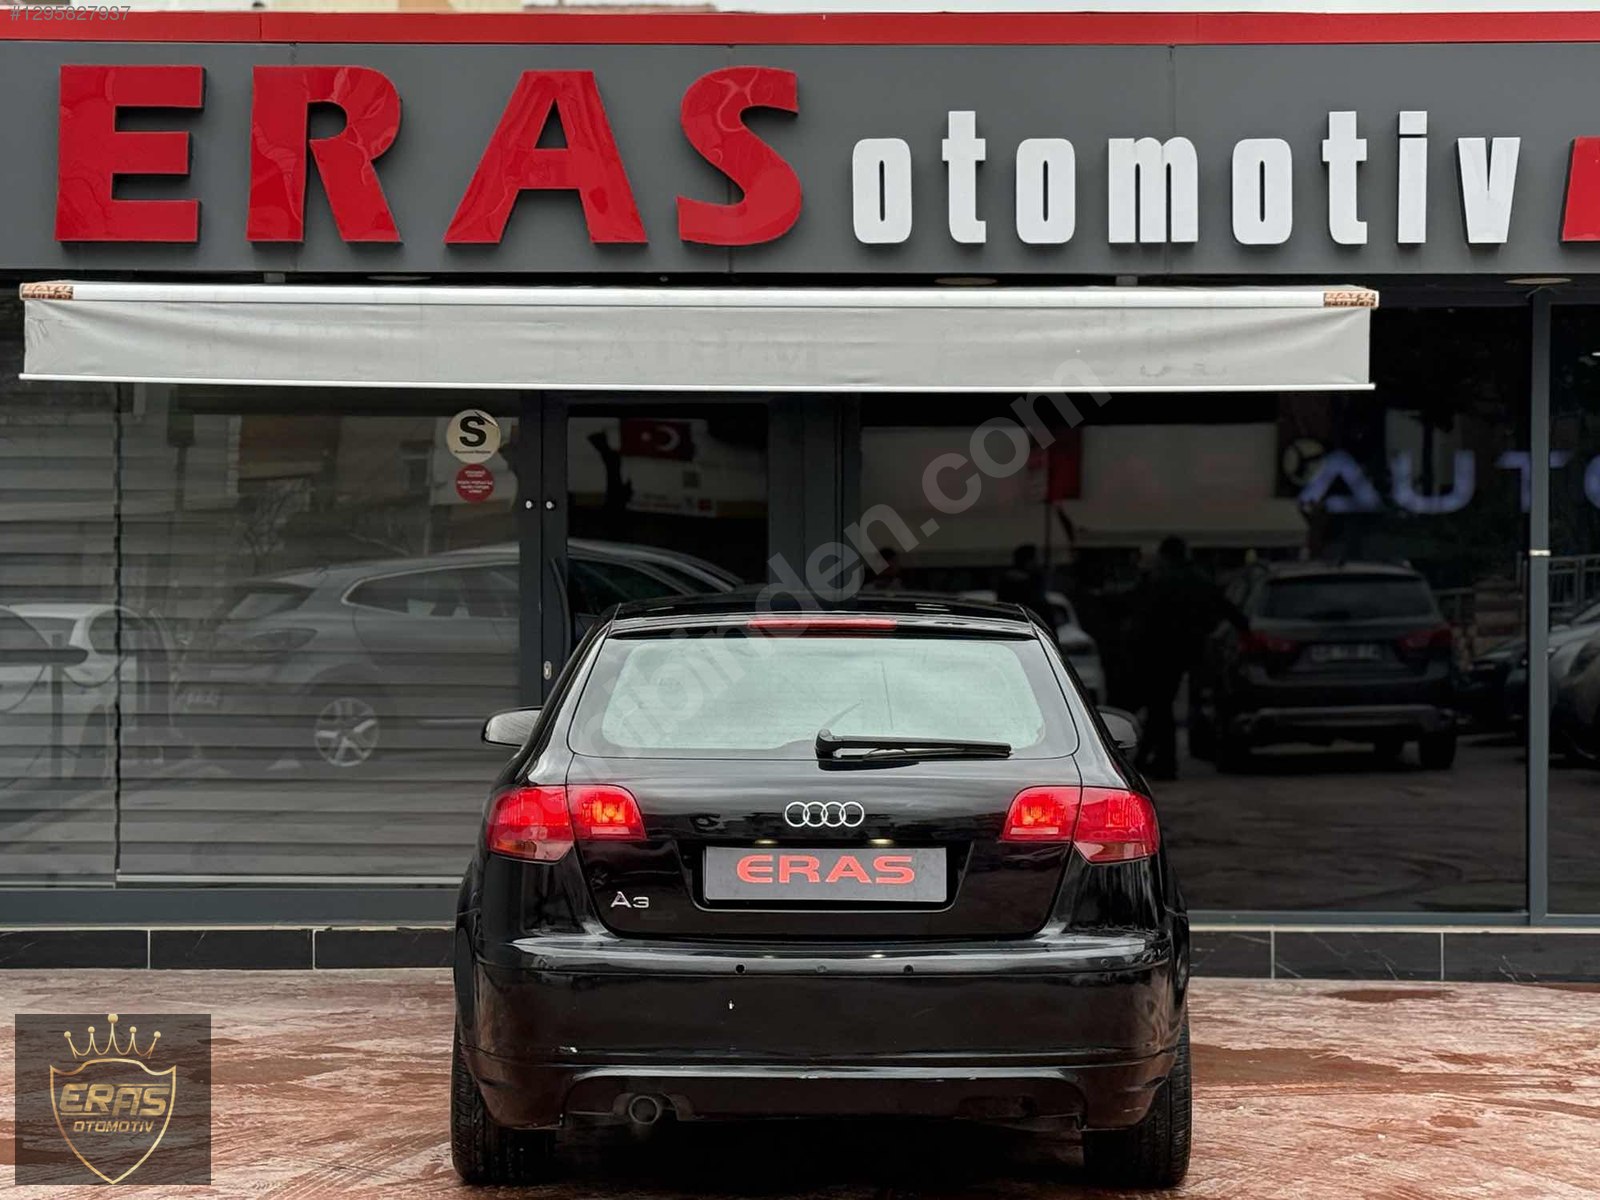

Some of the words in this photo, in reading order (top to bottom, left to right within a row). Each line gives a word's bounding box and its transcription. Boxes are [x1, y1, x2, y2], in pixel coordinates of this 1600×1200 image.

[56, 65, 804, 246] ERAS
[852, 111, 1521, 244] otomotiv
[459, 416, 487, 447] S
[736, 854, 915, 884] ERAS
[610, 891, 649, 909] A3
